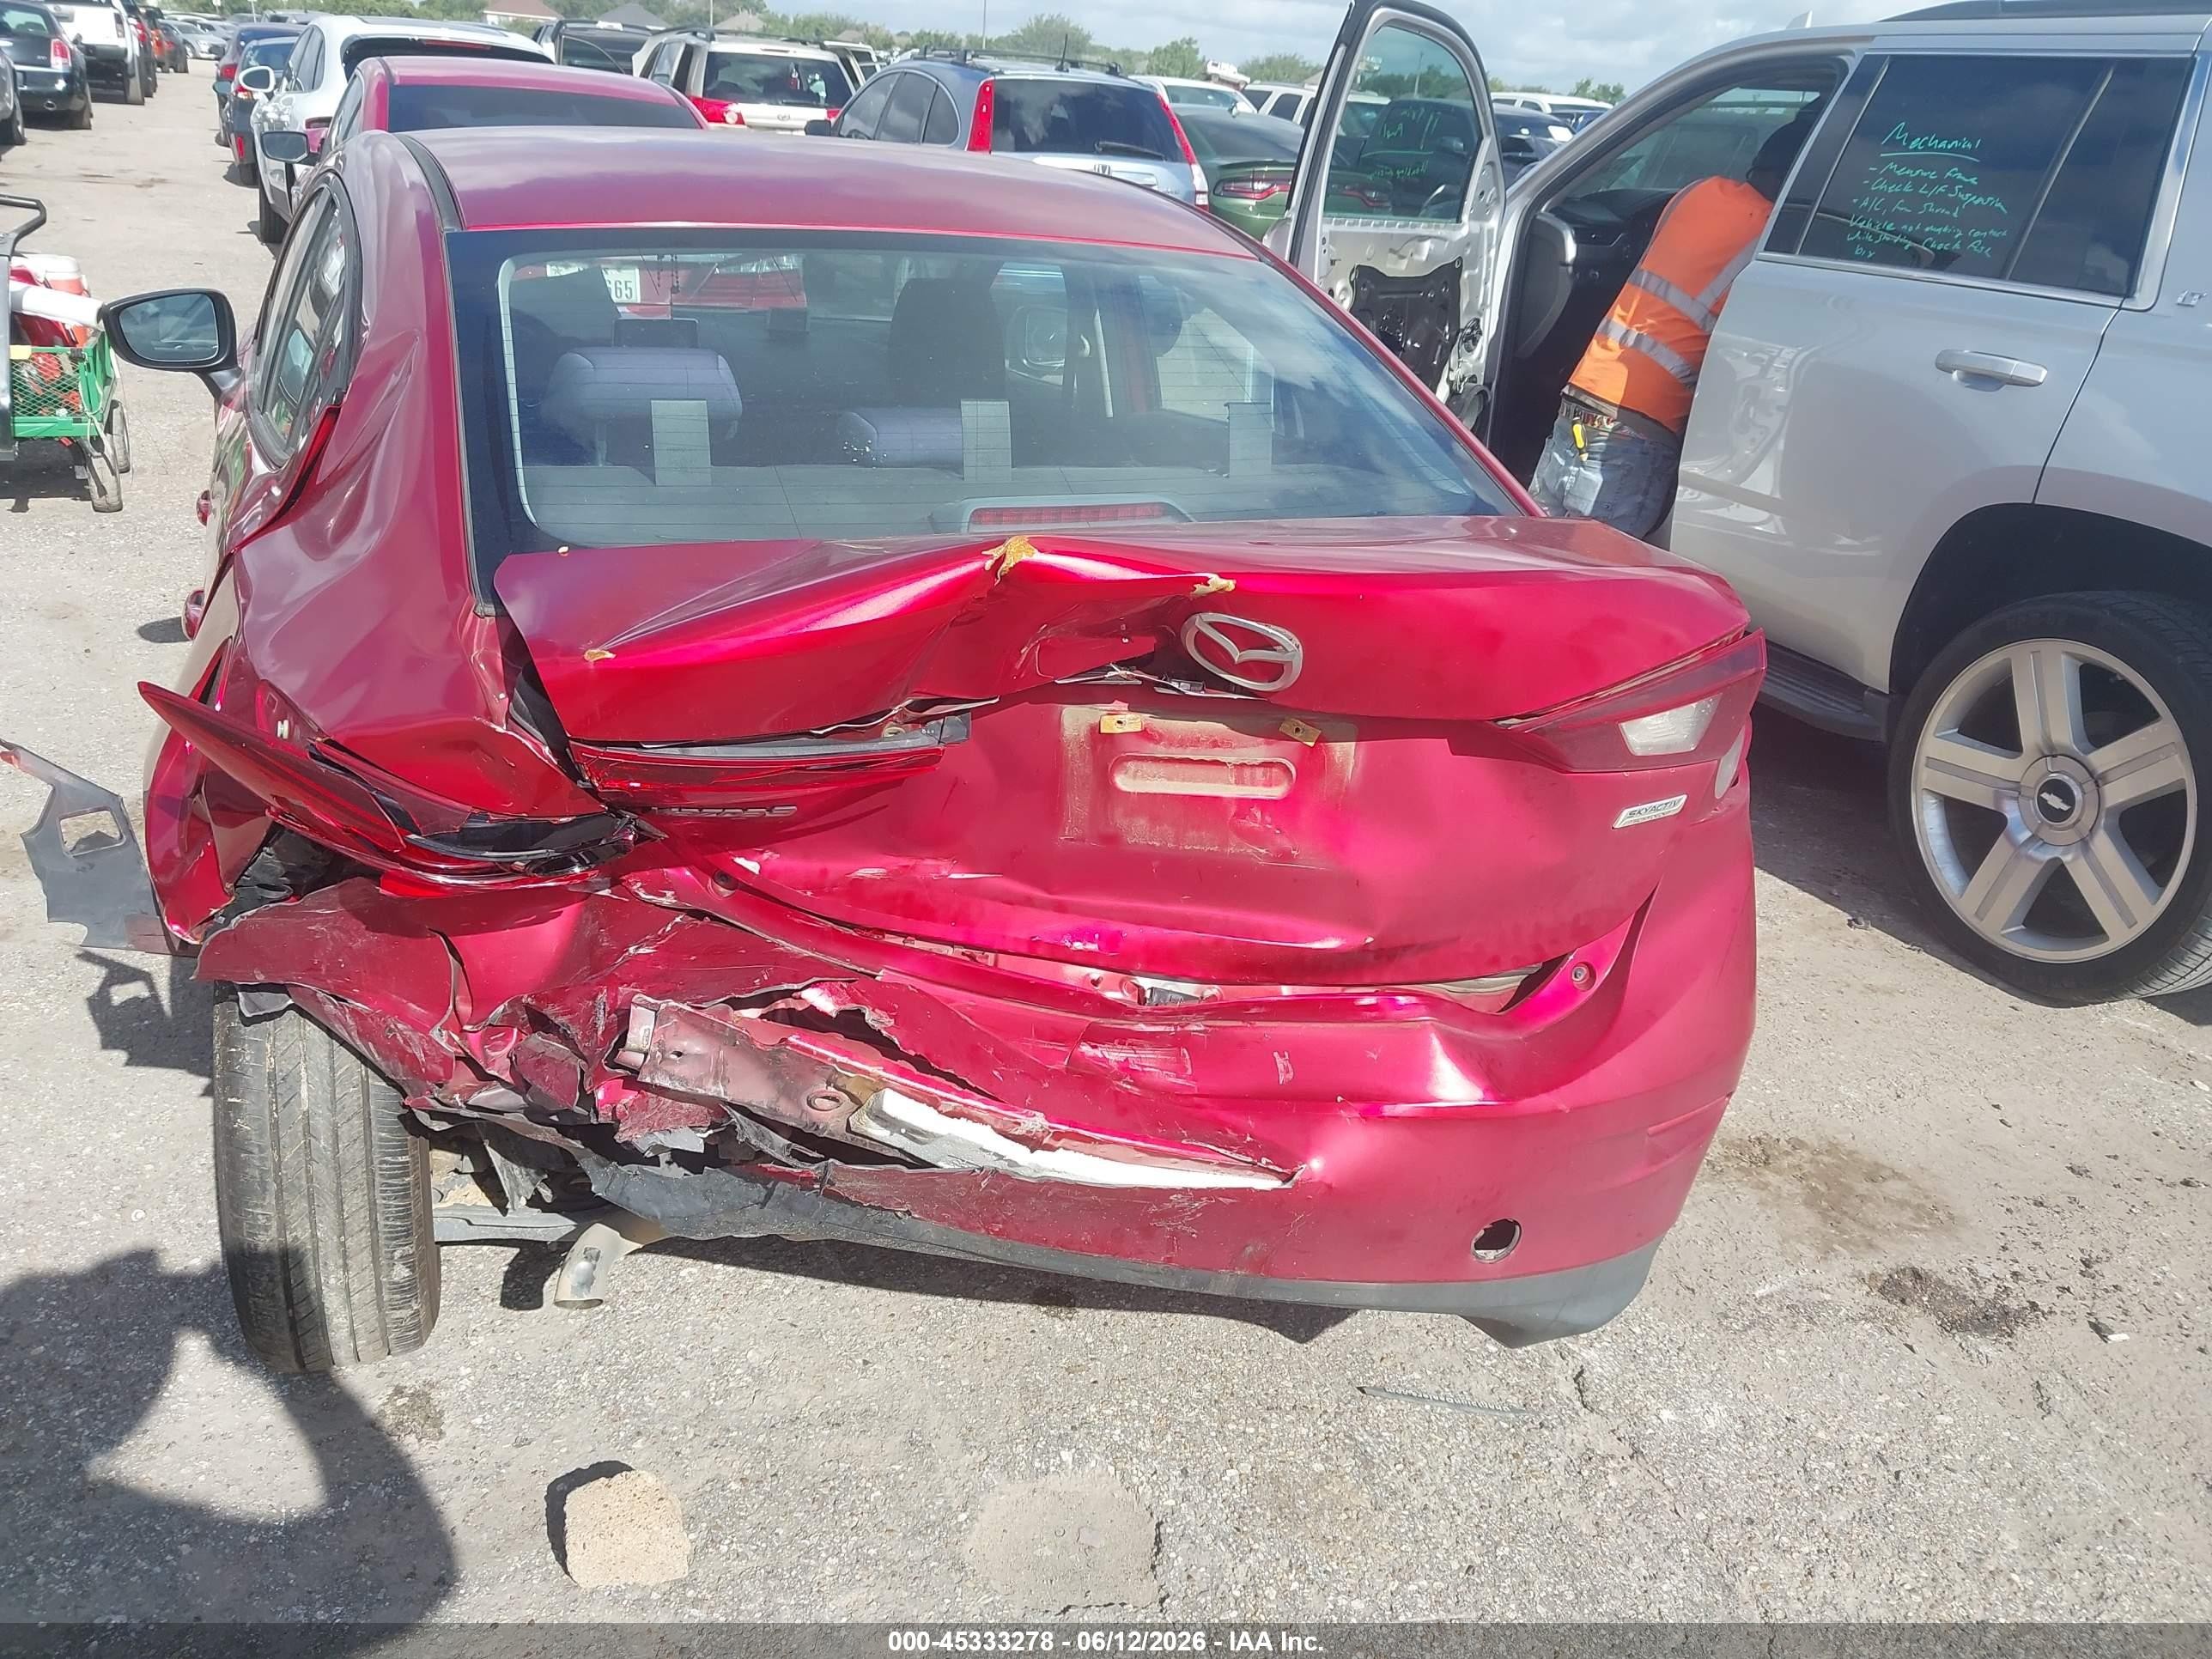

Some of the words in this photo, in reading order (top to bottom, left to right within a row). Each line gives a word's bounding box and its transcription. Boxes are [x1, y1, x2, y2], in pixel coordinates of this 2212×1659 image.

[1881, 122, 1981, 149] Mechanical
[1871, 178, 1914, 193] Check
[1848, 214, 1896, 231] Vehicle
